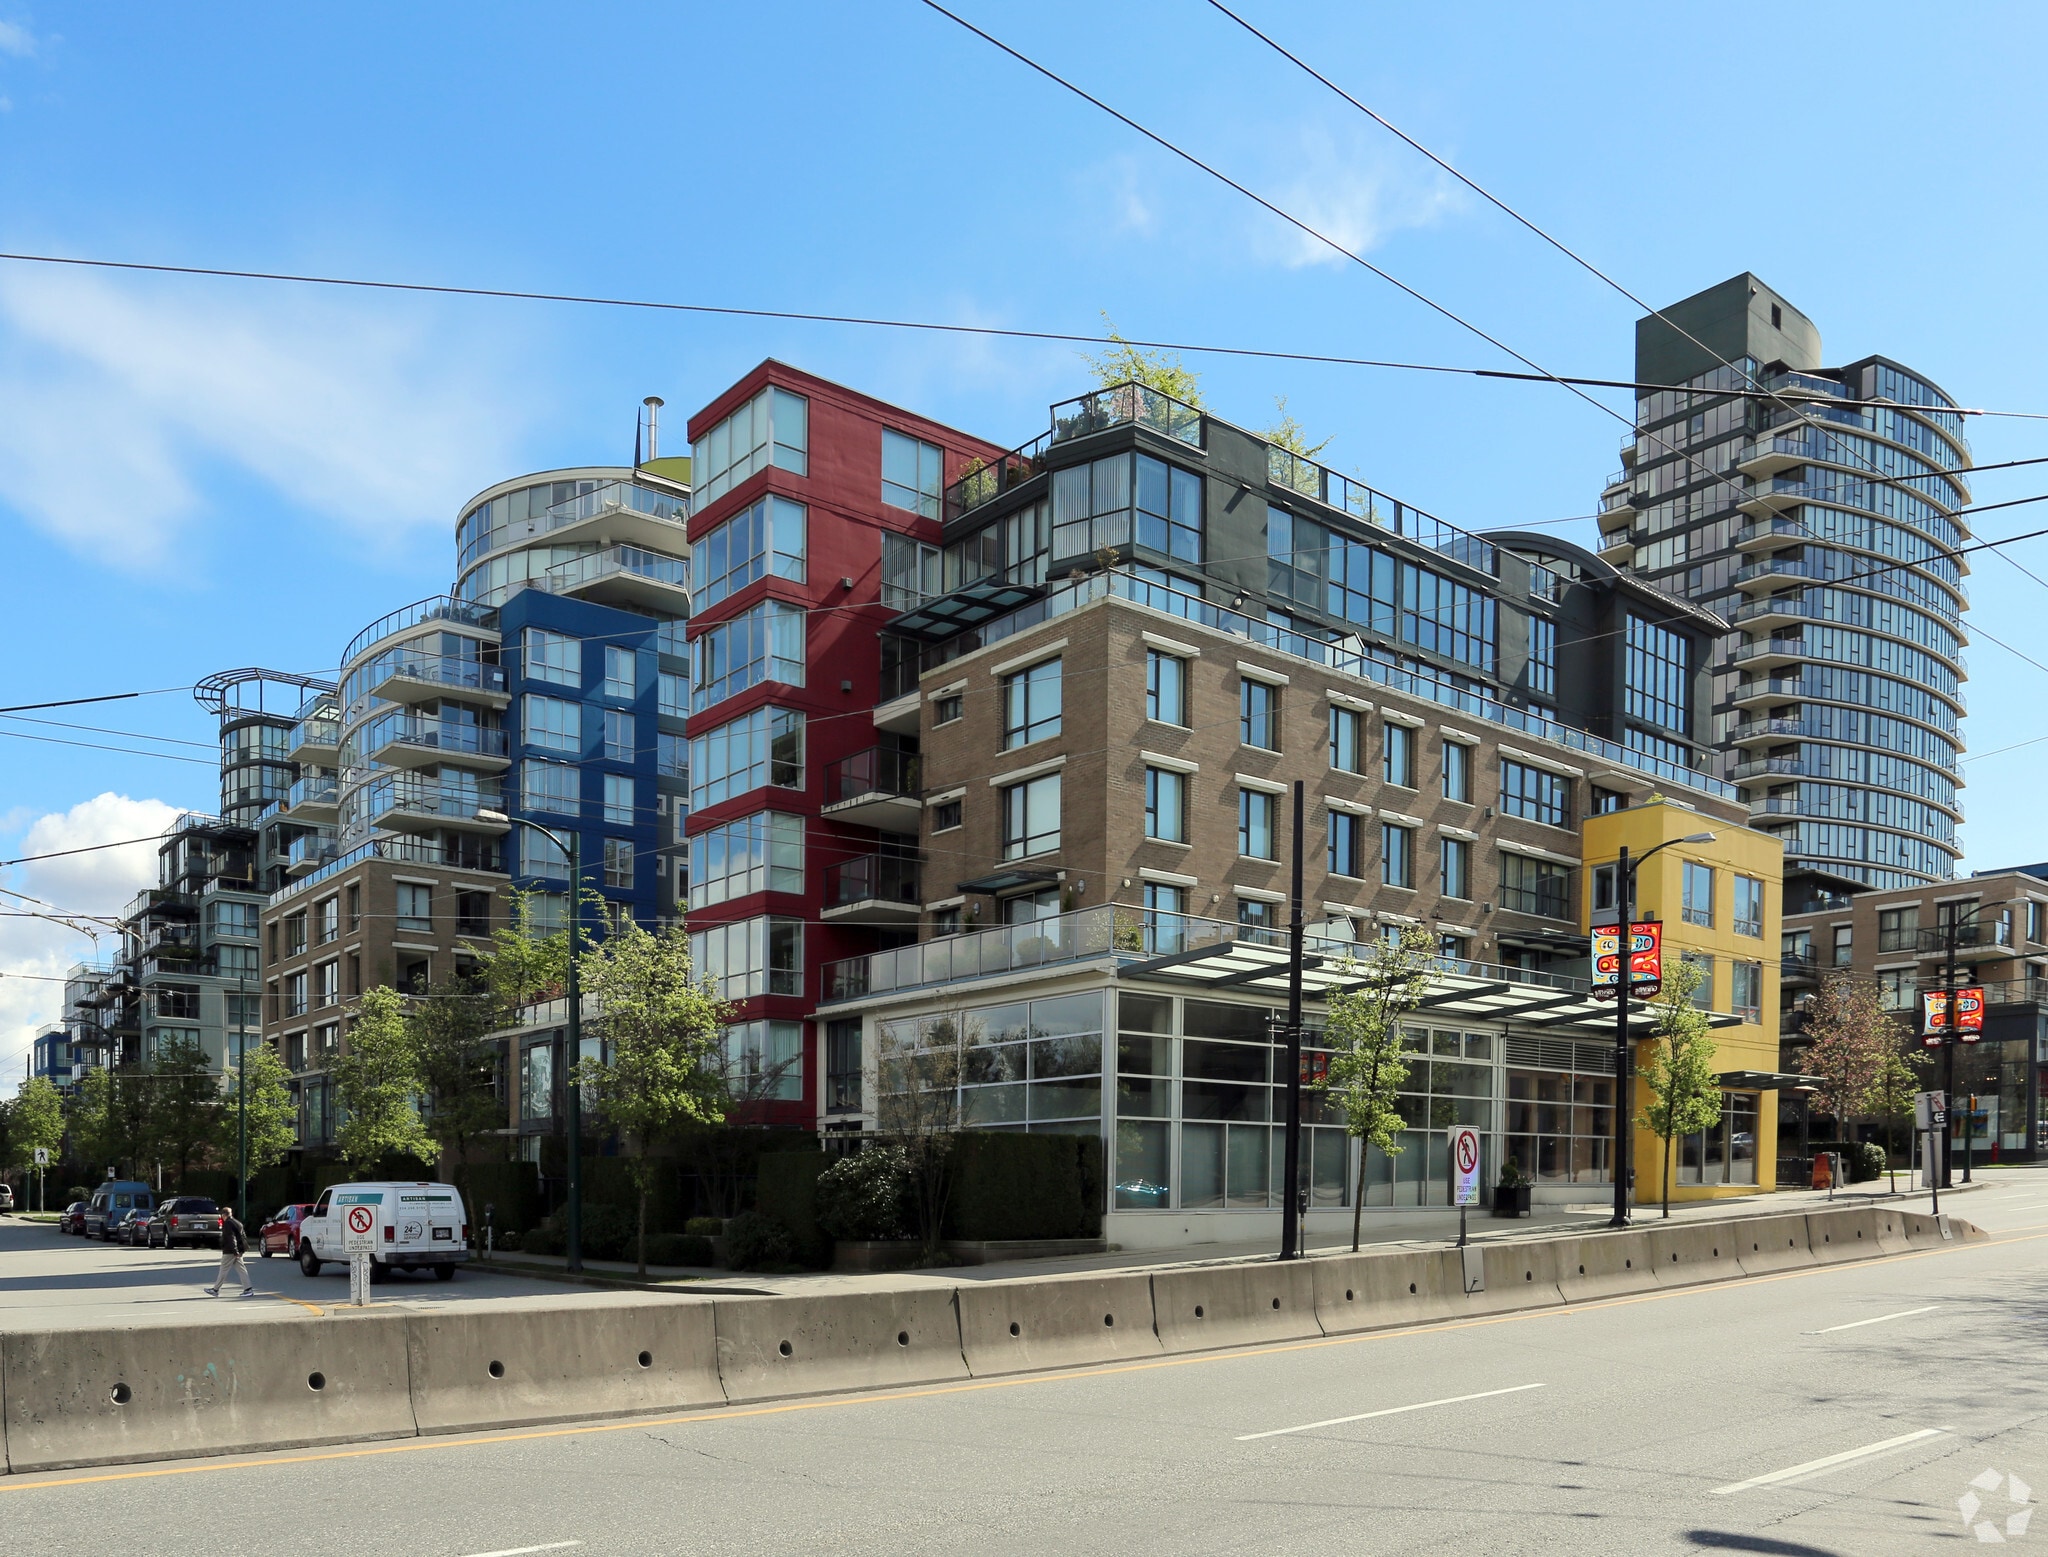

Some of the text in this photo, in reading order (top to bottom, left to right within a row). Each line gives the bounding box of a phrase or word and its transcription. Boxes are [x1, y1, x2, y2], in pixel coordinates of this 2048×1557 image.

[1456, 1185, 1477, 1193] PEDESTRIAN
[338, 1195, 359, 1203] ARTISAN
[1456, 1193, 1477, 1201] UNDERPASS
[404, 1225, 413, 1233] 24
